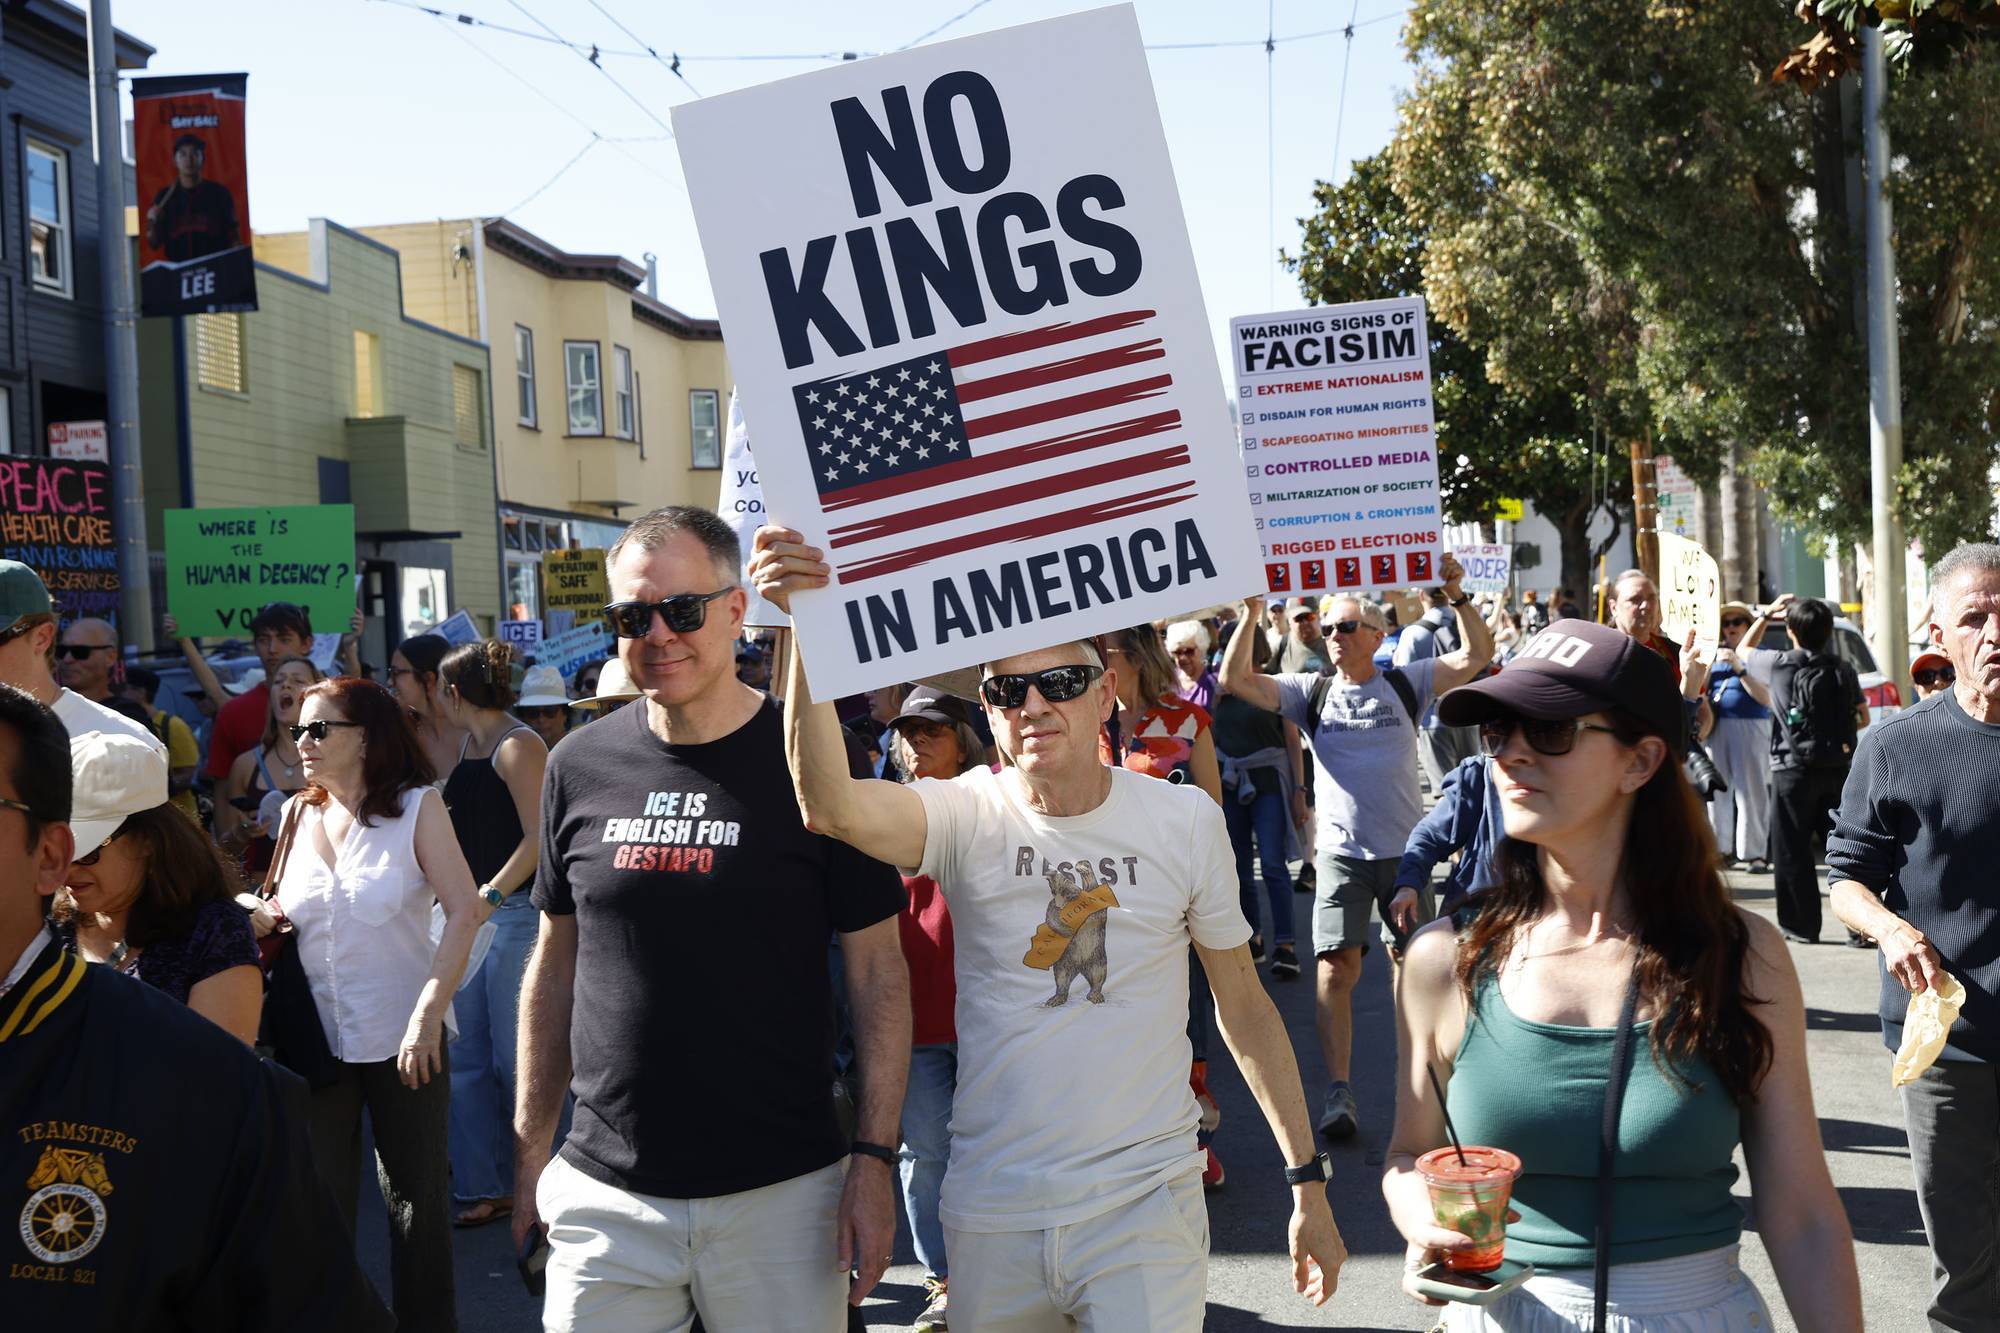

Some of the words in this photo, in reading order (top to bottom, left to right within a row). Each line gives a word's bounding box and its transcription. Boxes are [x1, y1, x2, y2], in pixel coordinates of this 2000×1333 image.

[830, 70, 1011, 218] NO
[759, 174, 1143, 369] KINGS
[181, 271, 215, 299] LEE
[1240, 320, 1325, 341] WARNING
[1331, 315, 1385, 332] SIGNS
[1391, 312, 1415, 325] OF
[1243, 328, 1416, 372] FACISIM
[1257, 379, 1324, 395] EXTREME
[1328, 371, 1424, 390] NATIONALISM
[1259, 409, 1307, 422] DISDAIN
[1309, 406, 1333, 417] FOR
[1336, 402, 1379, 414] HUMAN
[1383, 398, 1426, 411] RIGHTS
[1262, 431, 1354, 447] SCAPEGOATING
[1358, 424, 1429, 439] MINORITIES
[1264, 455, 1373, 476] CONTROLLED
[1378, 450, 1430, 467] MEDIA
[0, 461, 105, 513] PEACE
[1266, 487, 1360, 502] MILITARIZATION
[1363, 484, 1379, 494] OF
[1383, 479, 1434, 492] SOCIETY
[2, 511, 61, 544] HEALTH
[63, 515, 112, 545] CARE
[199, 520, 256, 536] WHERE
[1269, 512, 1350, 528] CORRUPTION
[1355, 510, 1363, 520] &
[1368, 505, 1435, 519] CRONYISM
[231, 544, 263, 556] THE
[1272, 537, 1336, 556] RIGGED
[1341, 530, 1437, 551] ELECTIONS
[186, 563, 250, 585] HUMAN
[549, 561, 598, 573] OPERATION
[1462, 557, 1508, 580] NDER
[845, 588, 918, 663] IN
[932, 518, 1217, 645] AMERICA
[644, 791, 681, 816] ICE
[682, 792, 708, 817] IS
[602, 818, 692, 844] ENGLISH
[695, 820, 741, 846] FOR
[613, 844, 714, 873] GESTAPO
[1015, 846, 1138, 886] RESST
[18, 1121, 138, 1153] TEAMSTERS
[9, 1263, 68, 1281] LOCAL
[73, 1269, 96, 1284] 921
